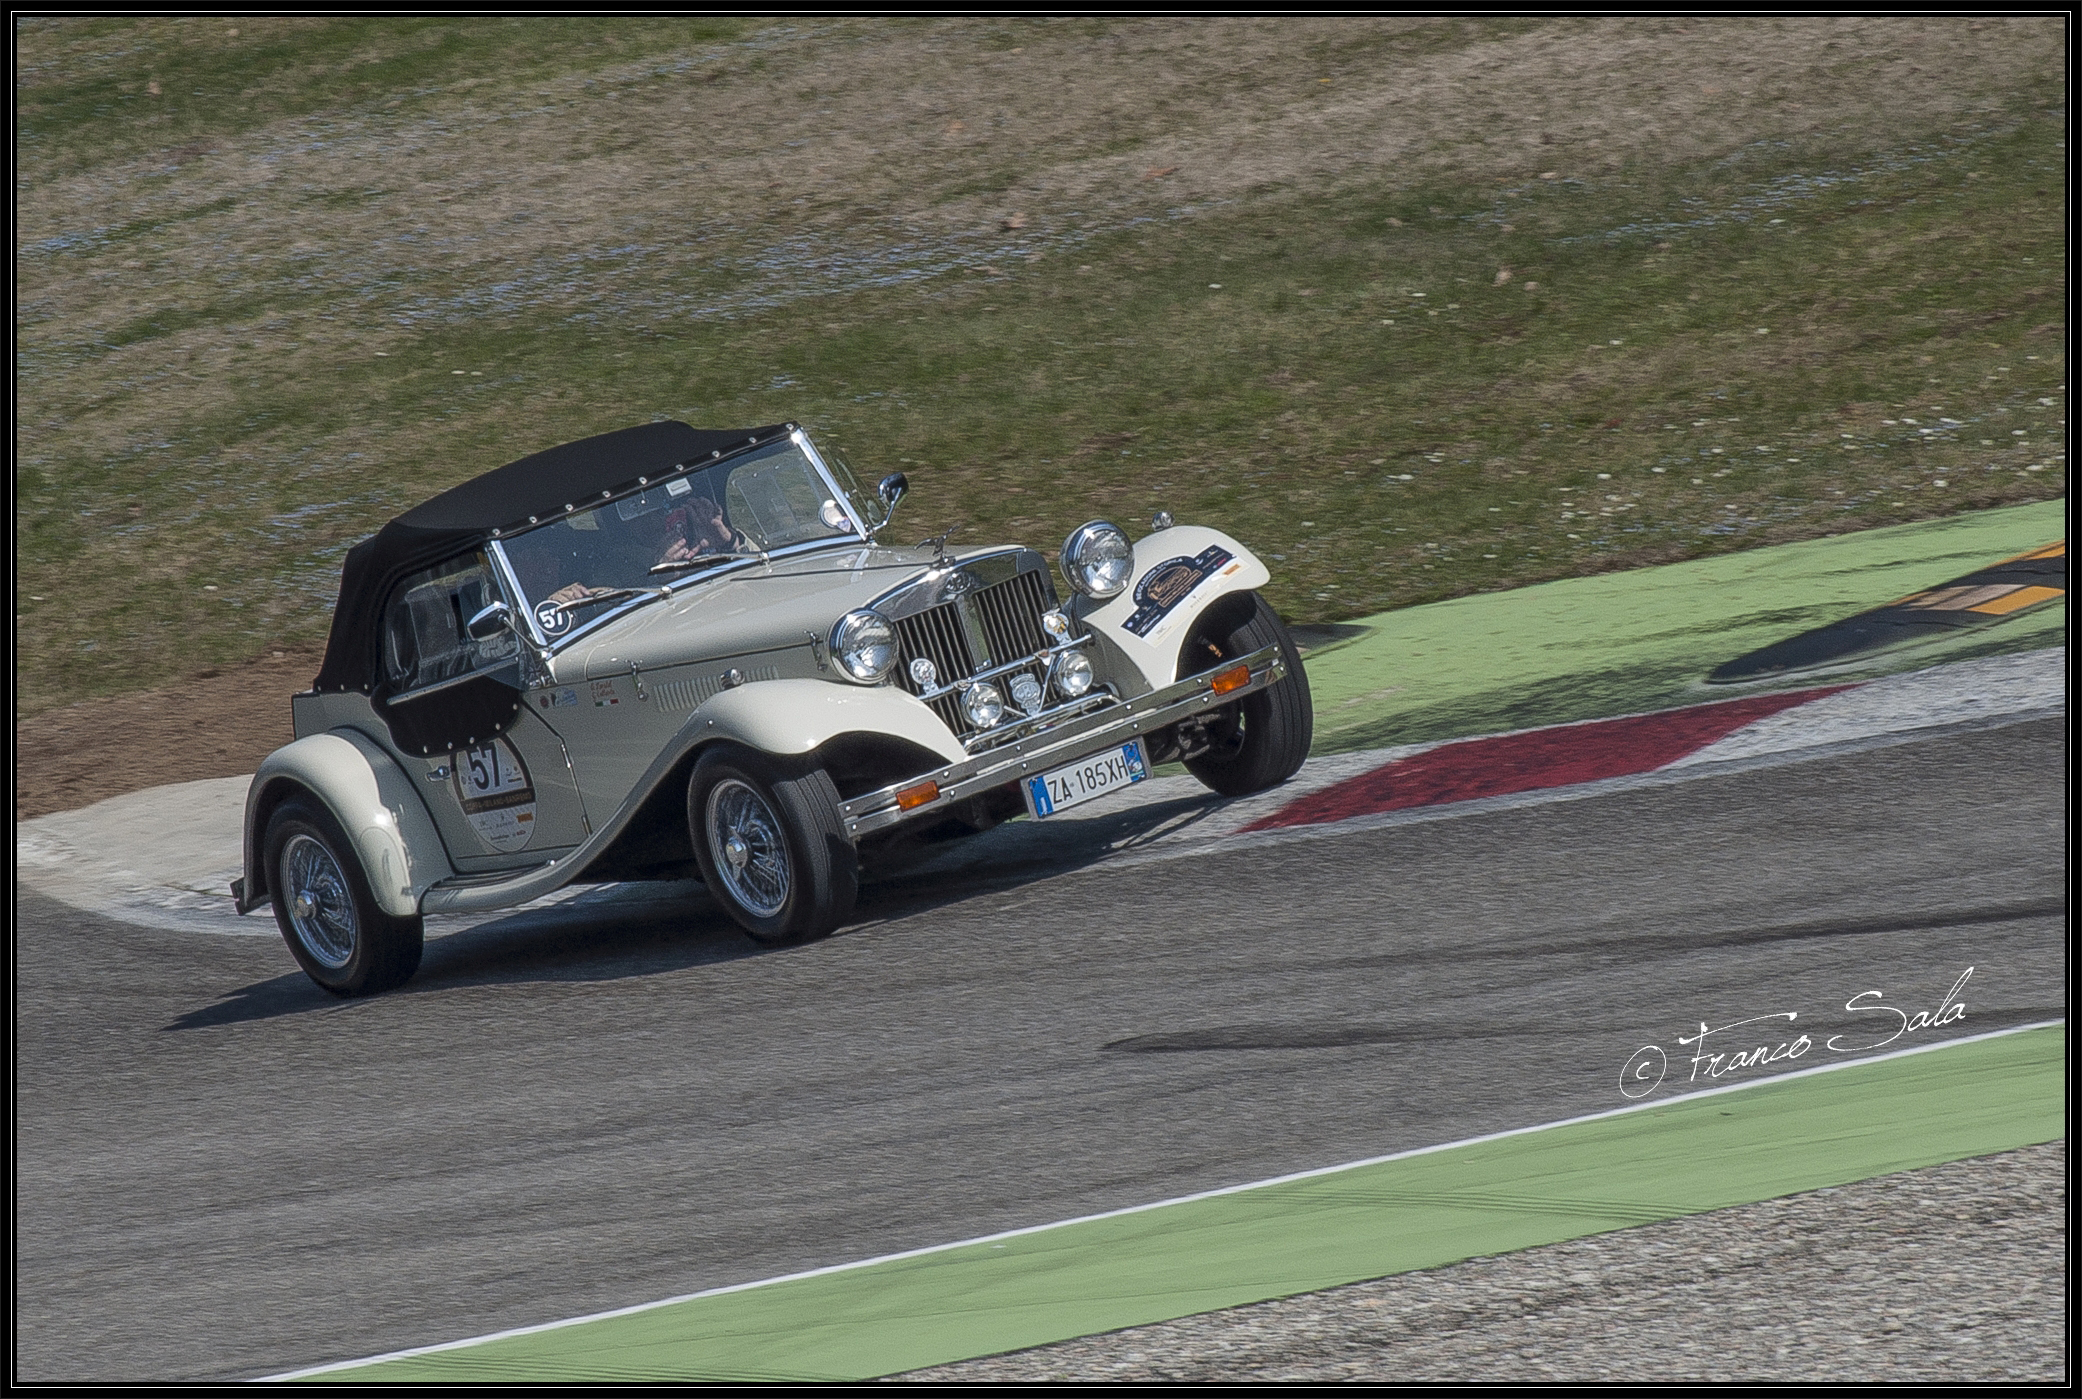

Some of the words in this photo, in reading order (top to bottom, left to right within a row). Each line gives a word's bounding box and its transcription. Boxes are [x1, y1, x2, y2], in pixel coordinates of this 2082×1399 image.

[538, 607, 563, 629] 57
[465, 742, 500, 790] 57
[1047, 776, 1072, 804] ZA
[1075, 755, 1128, 793] 185XH
